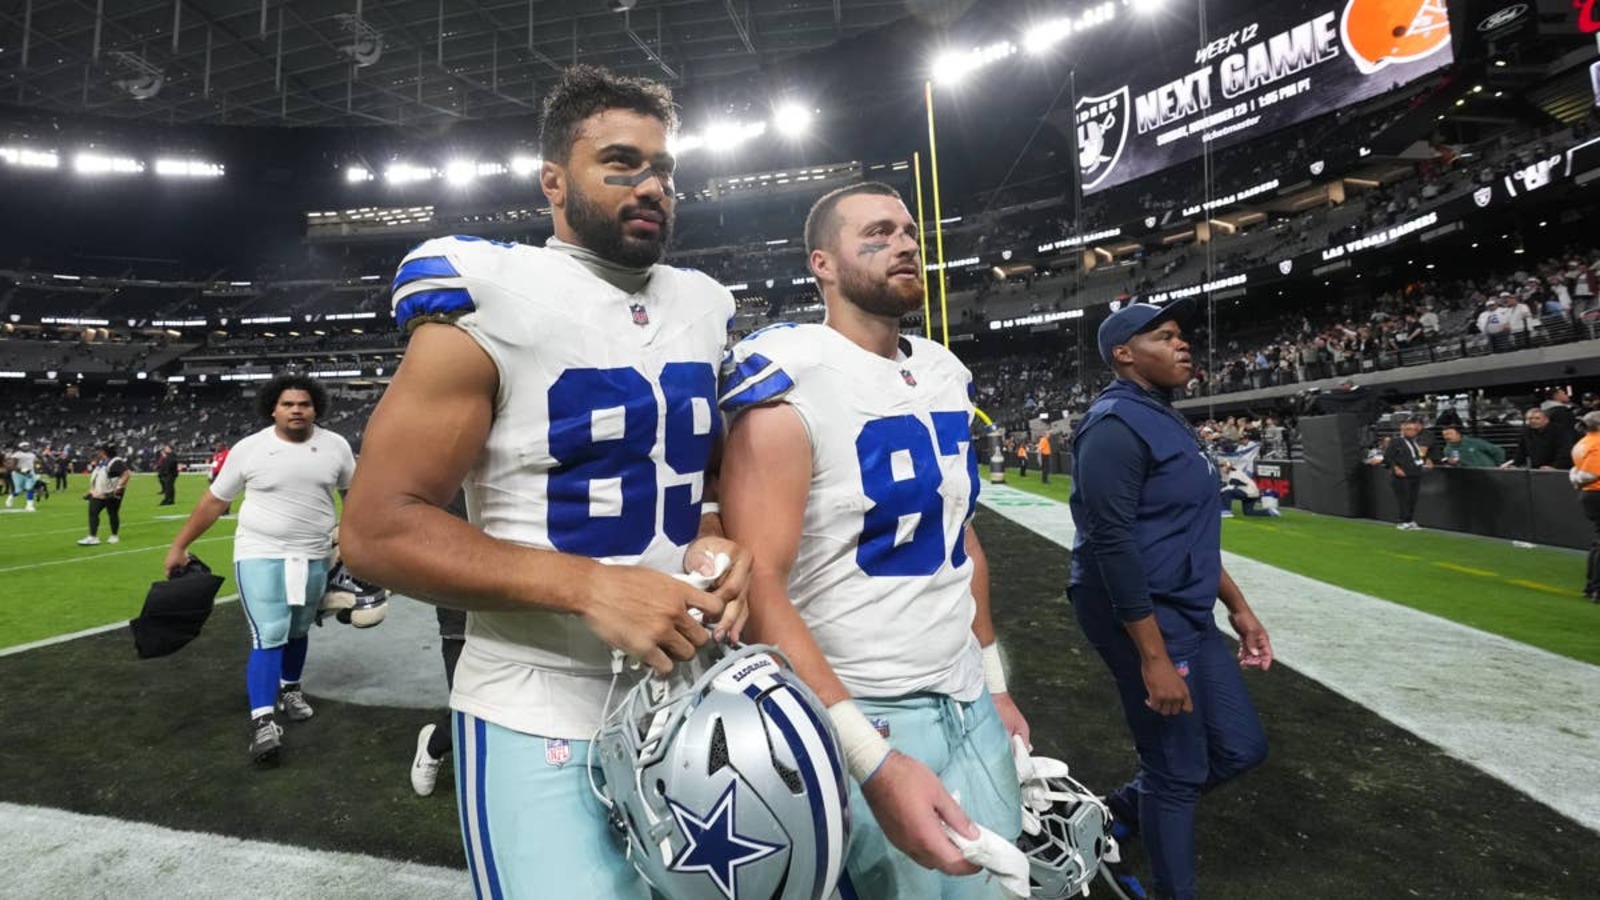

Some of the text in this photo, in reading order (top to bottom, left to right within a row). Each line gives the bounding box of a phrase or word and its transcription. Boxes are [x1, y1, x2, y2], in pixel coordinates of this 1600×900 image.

[1195, 23, 1259, 63] WEEK 12
[1135, 11, 1339, 134] NEXT GAME
[1234, 102, 1248, 117] 23
[1297, 77, 1311, 94] PT
[1182, 179, 1280, 217] LAS VEGAS RAIDERS
[1038, 228, 1121, 253] LAS VEGAS RAIDERS
[1322, 211, 1438, 261] LAS VEGAS RAIDERS
[1149, 274, 1247, 303] LAS VEGAS RAIDERS
[546, 361, 724, 558] 89
[855, 410, 981, 578] 87
